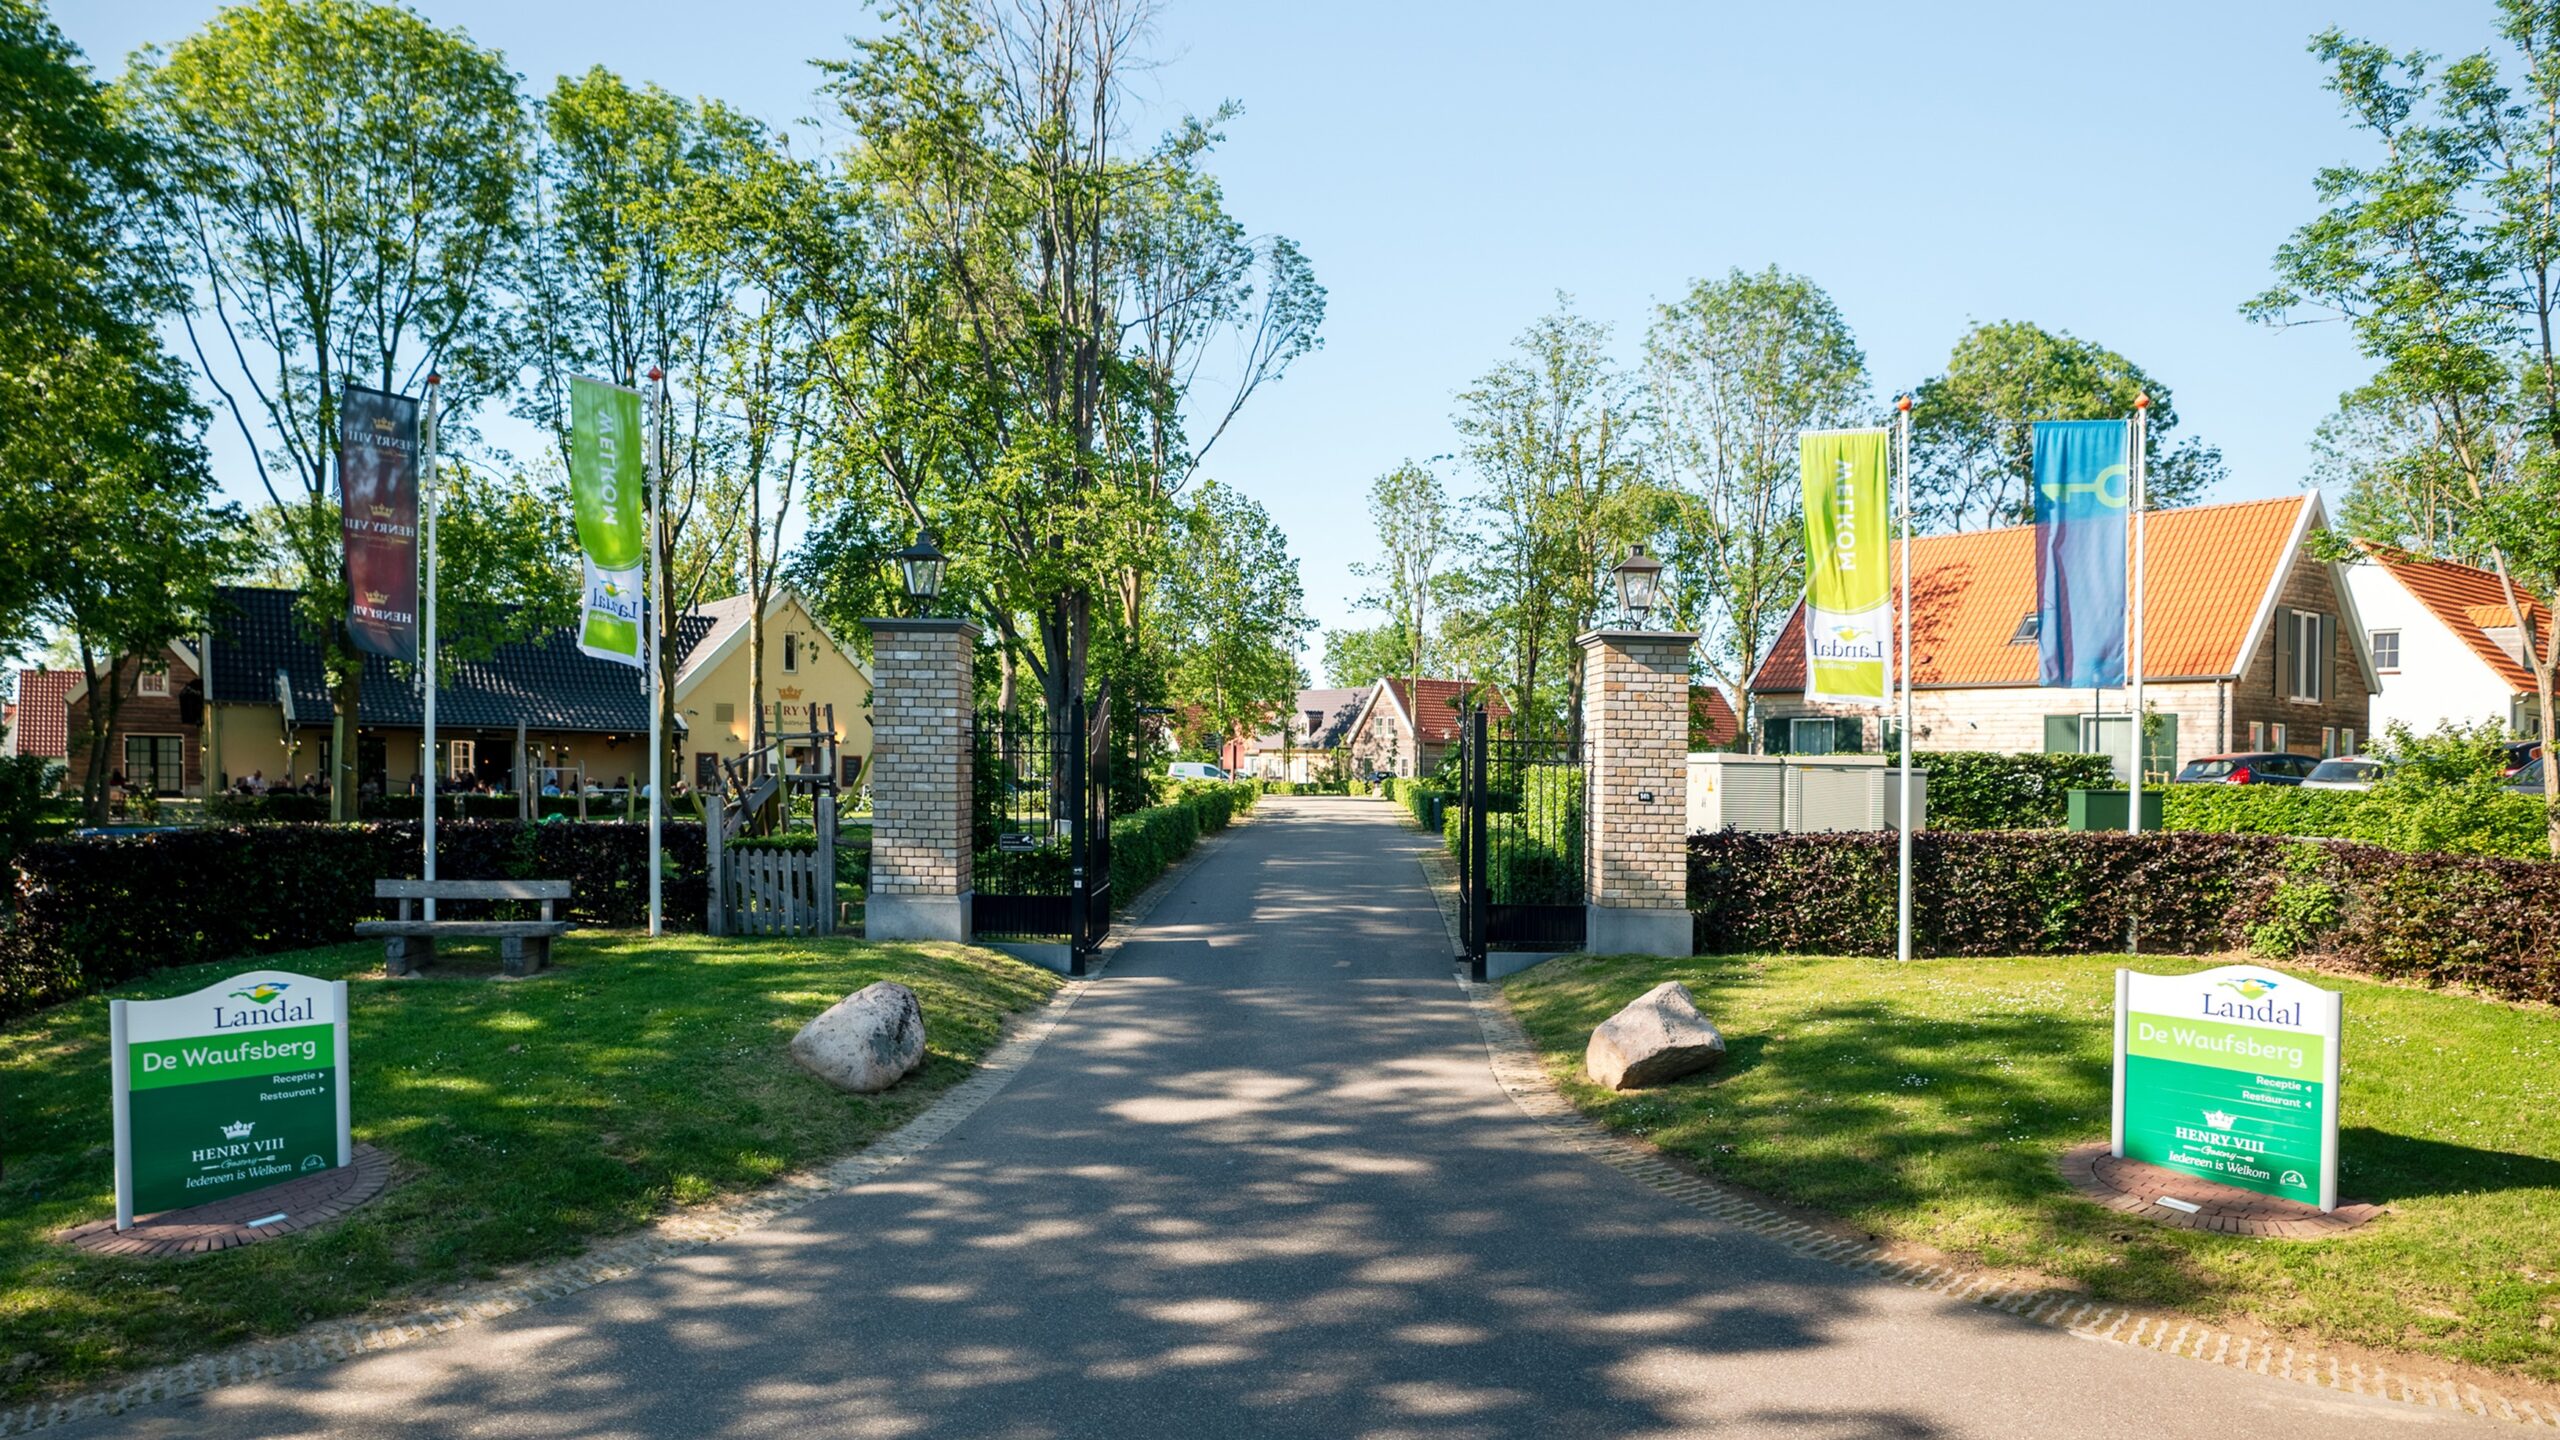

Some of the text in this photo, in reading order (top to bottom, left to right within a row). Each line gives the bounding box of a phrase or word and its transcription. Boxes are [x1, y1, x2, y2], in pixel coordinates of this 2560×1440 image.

[763, 705, 827, 717] ERY VII
[213, 997, 314, 1029] Landal
[2202, 993, 2303, 1027] Landal
[143, 1040, 316, 1072] De Waufsberg
[2138, 1022, 2303, 1068] De Waufsberg
[272, 1072, 316, 1085] Receptie
[2255, 1075, 2302, 1092] Receptie
[260, 1086, 316, 1102] Restaurant
[2242, 1091, 2302, 1109] Restaurant
[192, 1137, 285, 1162] HENRY VIII
[2175, 1126, 2265, 1154] HENRY VIII
[185, 1163, 292, 1189] Iedereen is Welkom
[2168, 1150, 2271, 1180] Iedereen is Welkom
